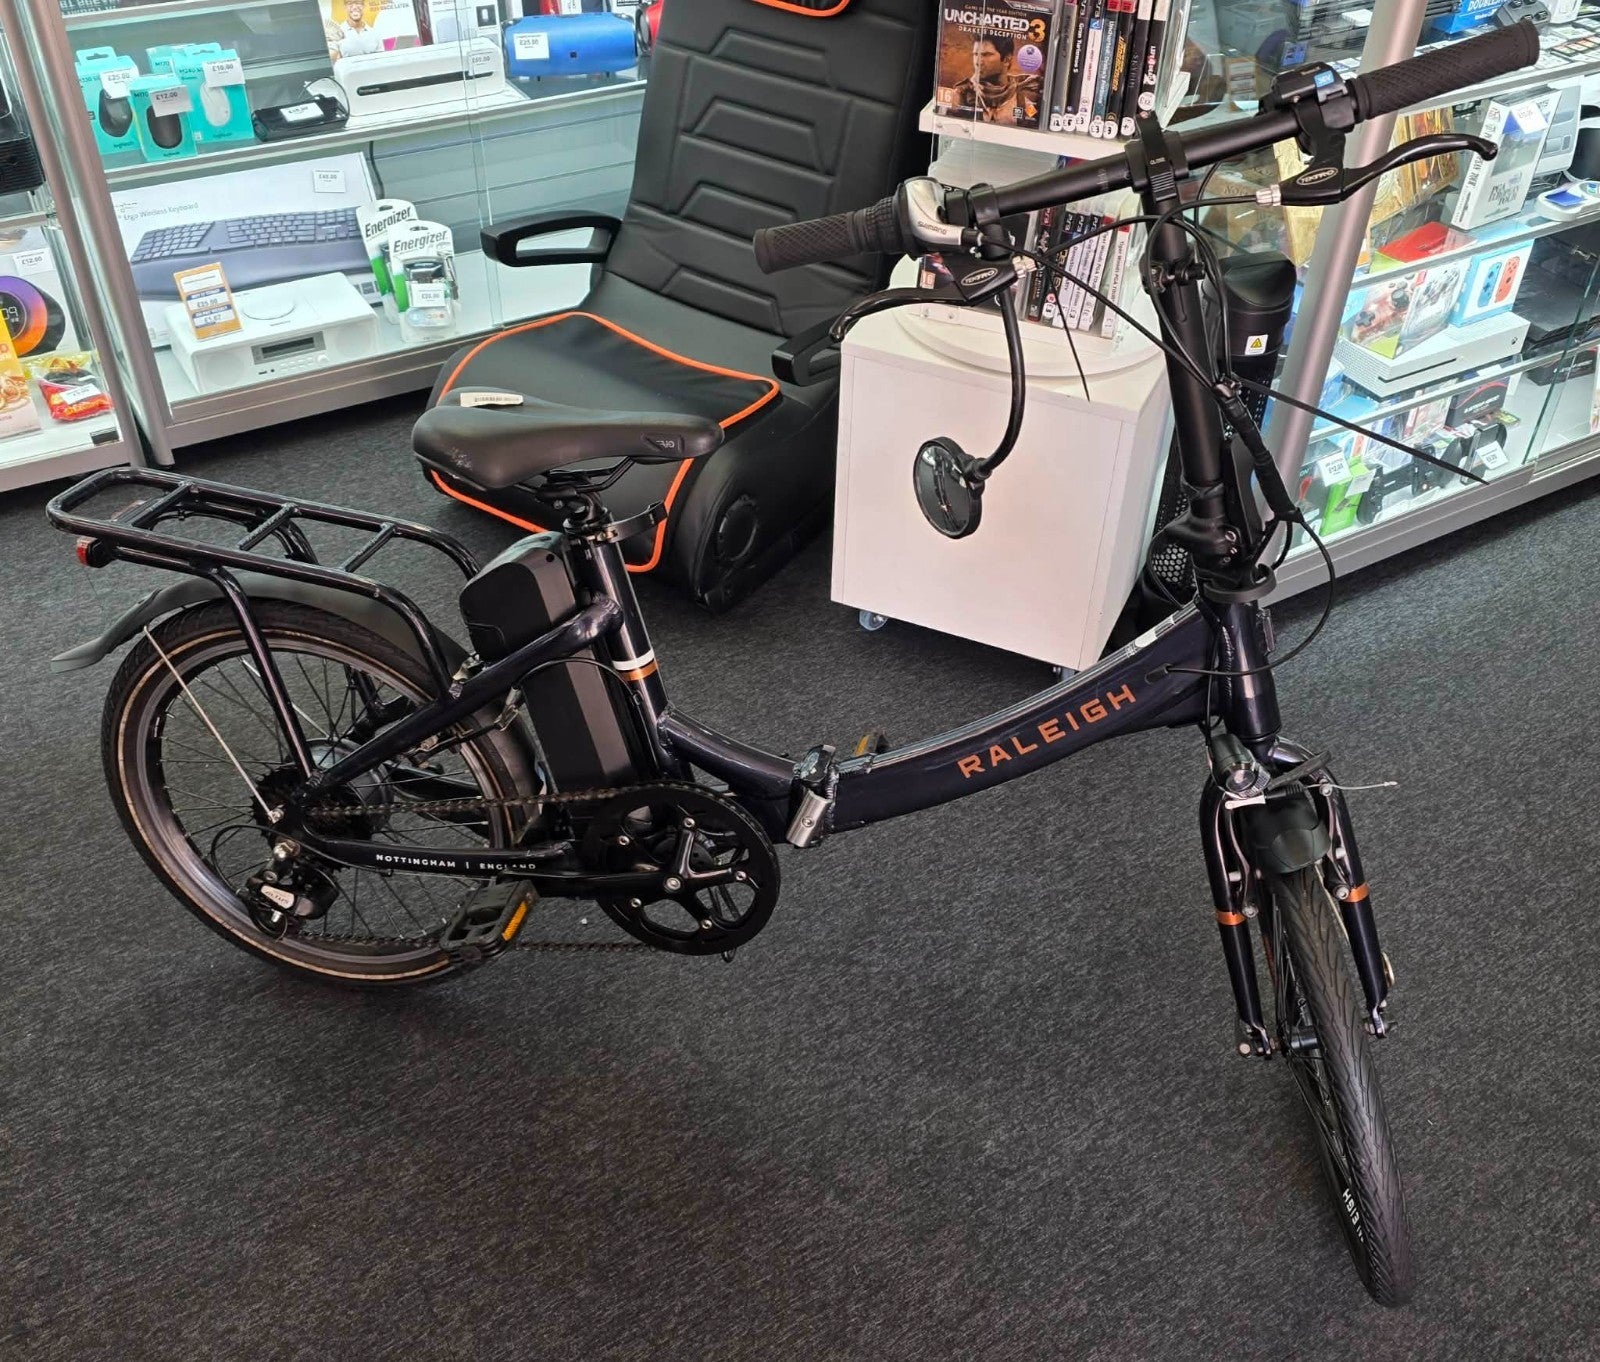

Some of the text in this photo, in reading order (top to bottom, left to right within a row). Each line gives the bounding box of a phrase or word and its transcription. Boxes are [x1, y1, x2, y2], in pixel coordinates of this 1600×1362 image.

[944, 8, 1046, 42] UNCHARTED 3
[989, 29, 1027, 40] DECEPTION
[1075, 39, 1084, 66] Turismo
[939, 89, 952, 102] 16
[1301, 170, 1335, 183] TEKTRO
[139, 206, 167, 219] Wireless
[168, 202, 199, 217] Keyboard
[917, 220, 948, 235] SHIMANO
[393, 230, 448, 253] Energizer
[957, 684, 1137, 779] RALEIGH
[376, 854, 456, 868] NOTTINGHAM
